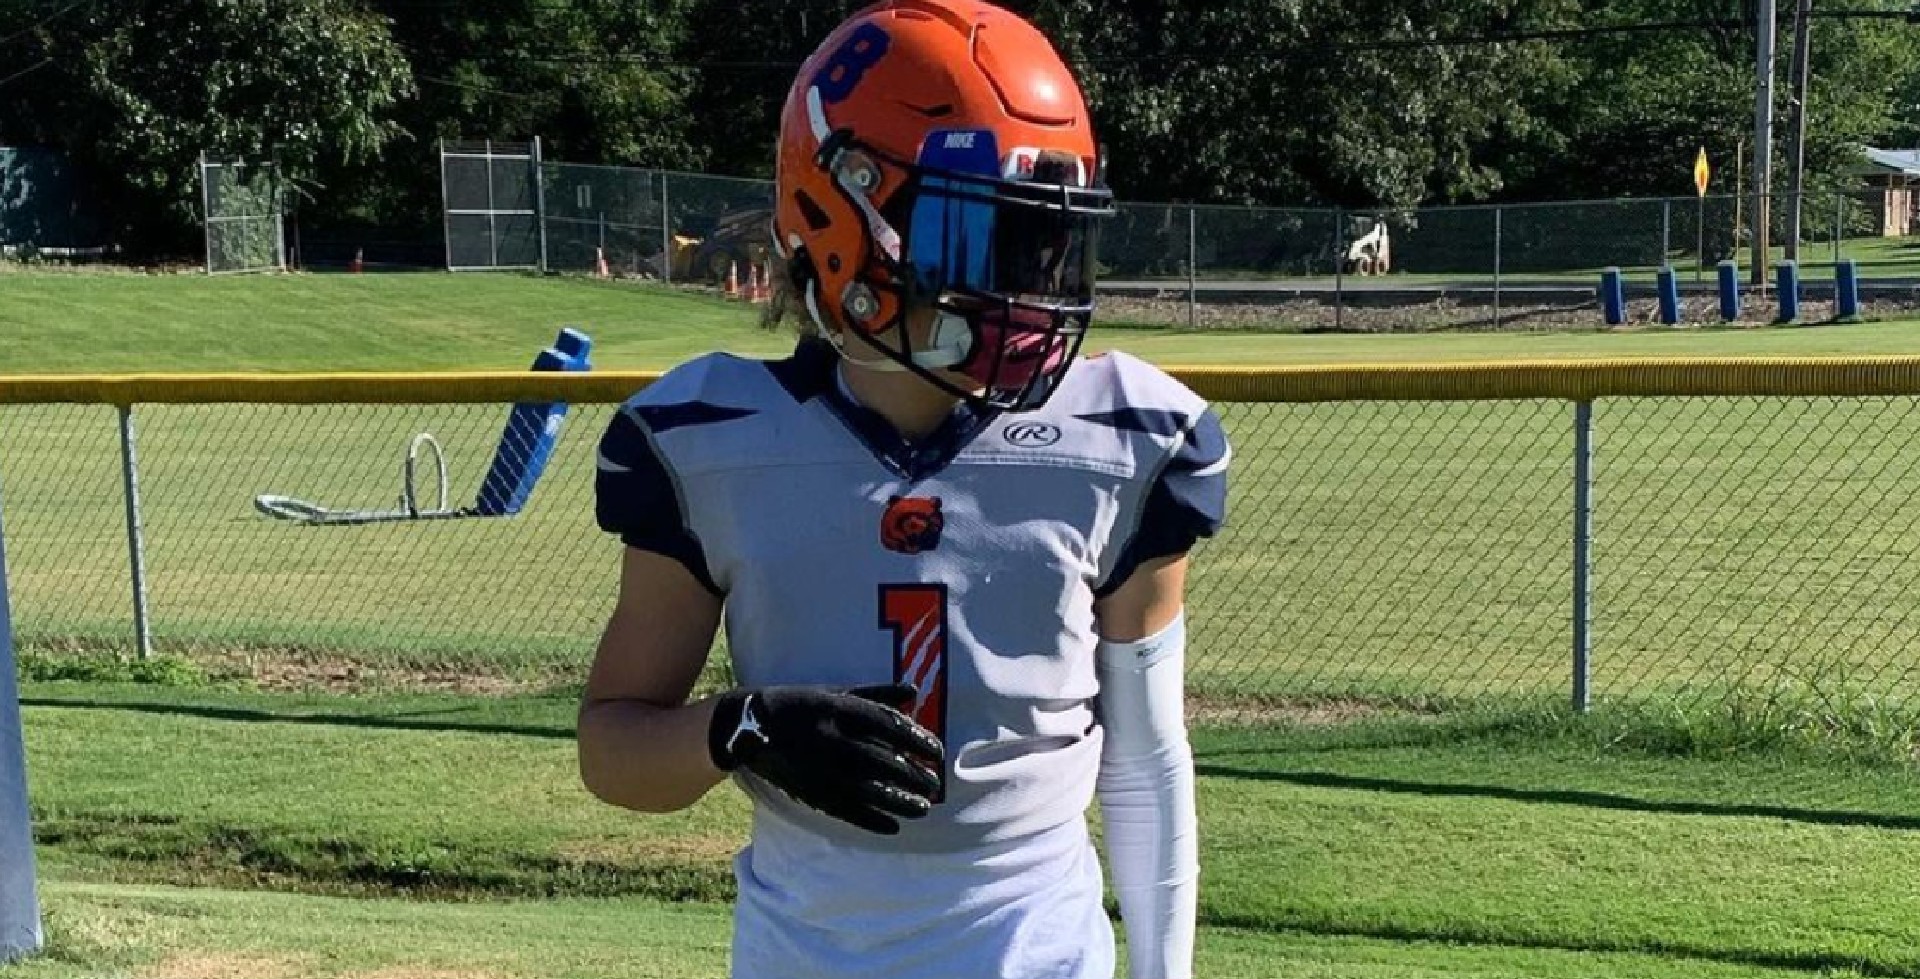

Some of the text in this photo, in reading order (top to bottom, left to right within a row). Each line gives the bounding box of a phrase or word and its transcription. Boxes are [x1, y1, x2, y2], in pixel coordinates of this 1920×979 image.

[813, 22, 890, 103] 8
[943, 132, 976, 149] NIKE
[877, 583, 948, 804] 1
